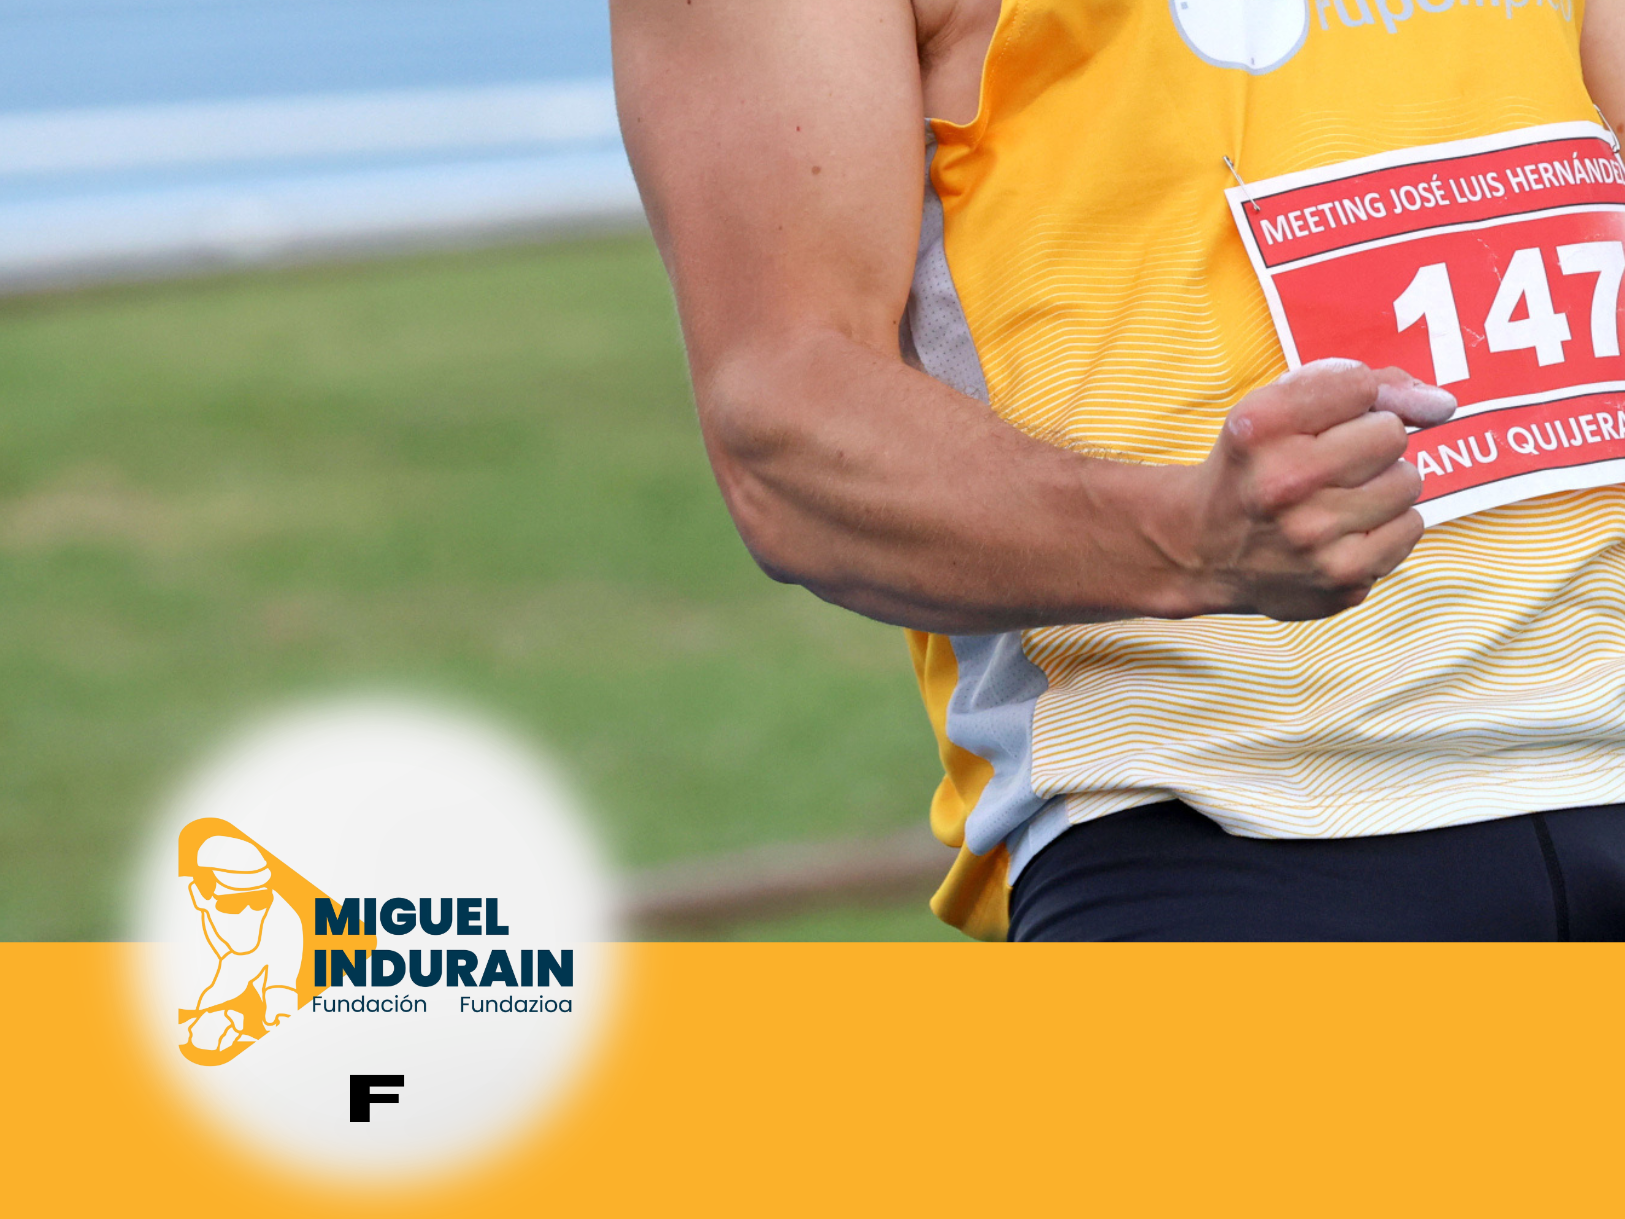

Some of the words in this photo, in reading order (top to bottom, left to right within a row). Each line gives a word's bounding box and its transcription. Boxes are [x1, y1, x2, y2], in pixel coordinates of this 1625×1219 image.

[1260, 189, 1386, 246] MEETING
[1389, 173, 1450, 214] JOSÉ
[1449, 171, 1506, 207] LUIS
[1398, 431, 1499, 481] ANU
